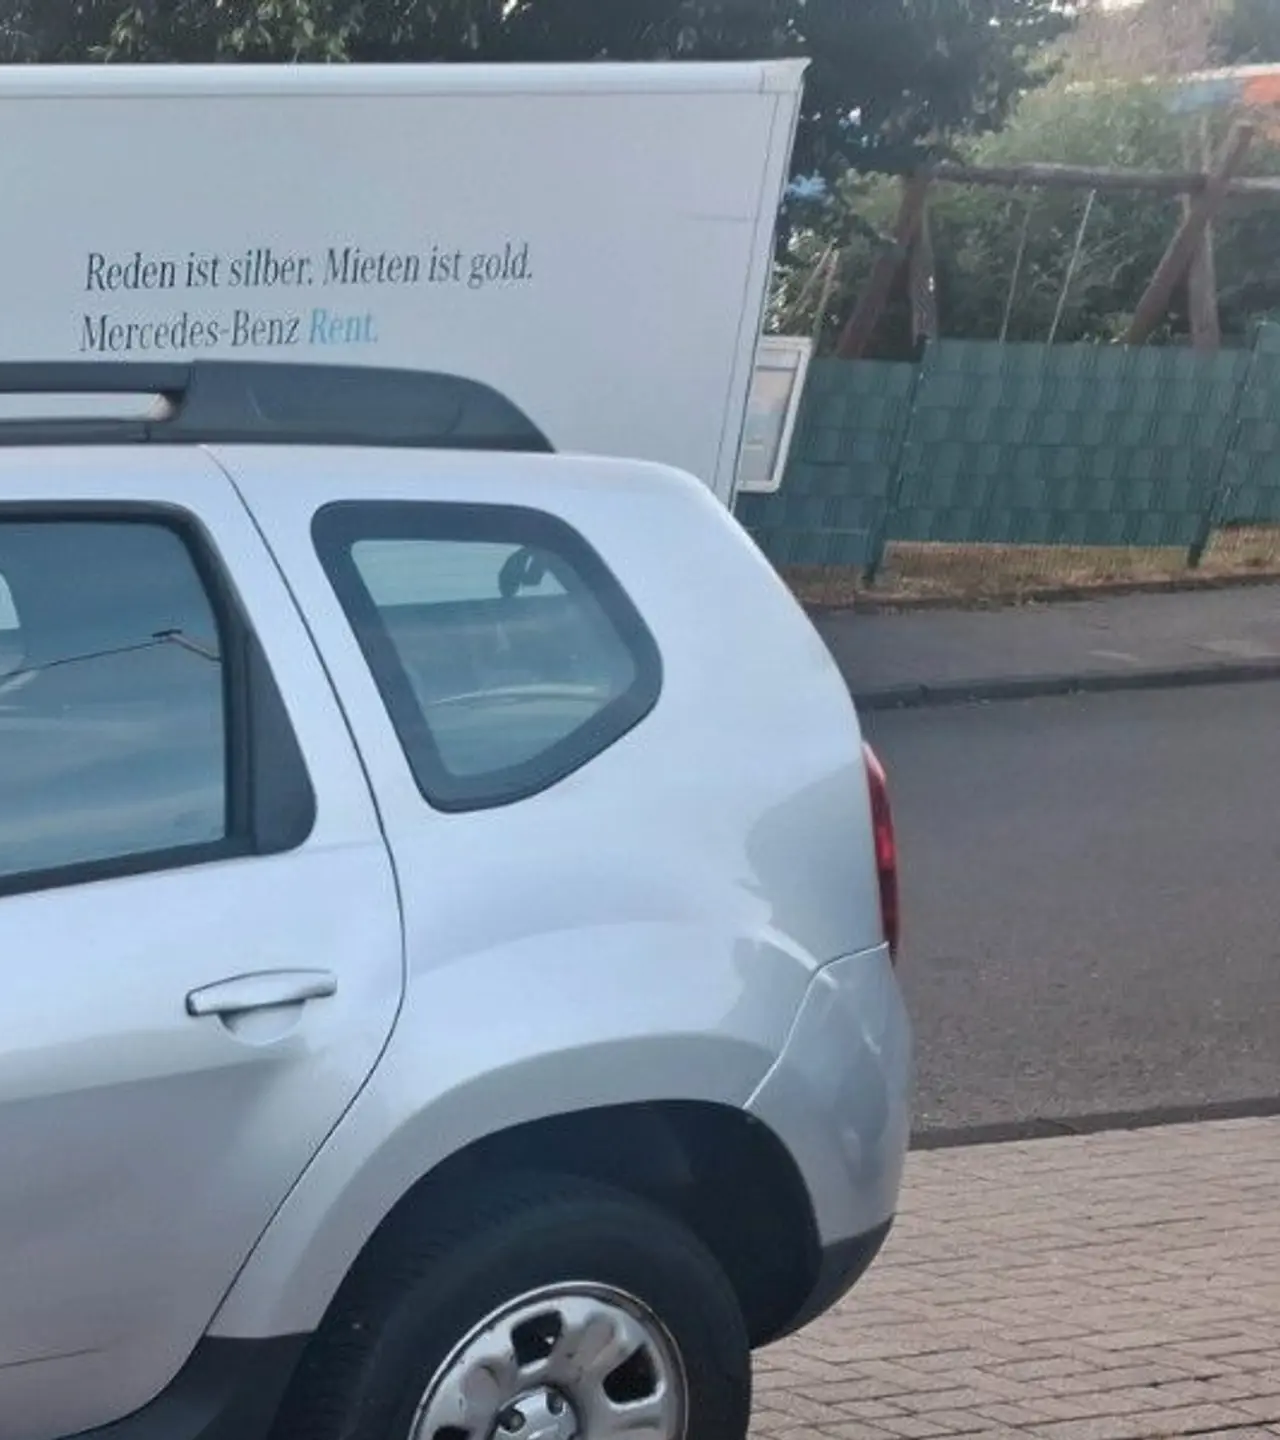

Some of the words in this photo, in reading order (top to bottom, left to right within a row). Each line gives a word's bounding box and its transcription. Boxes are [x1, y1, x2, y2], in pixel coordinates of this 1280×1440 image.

[85, 252, 176, 291] Reden
[186, 252, 219, 288] ist
[228, 249, 313, 287] silber.
[323, 246, 420, 285] Mieten
[428, 245, 463, 282] ist
[467, 242, 533, 290] gold.
[80, 309, 301, 351] Mercedes-Benz
[309, 307, 379, 345] Rent.
